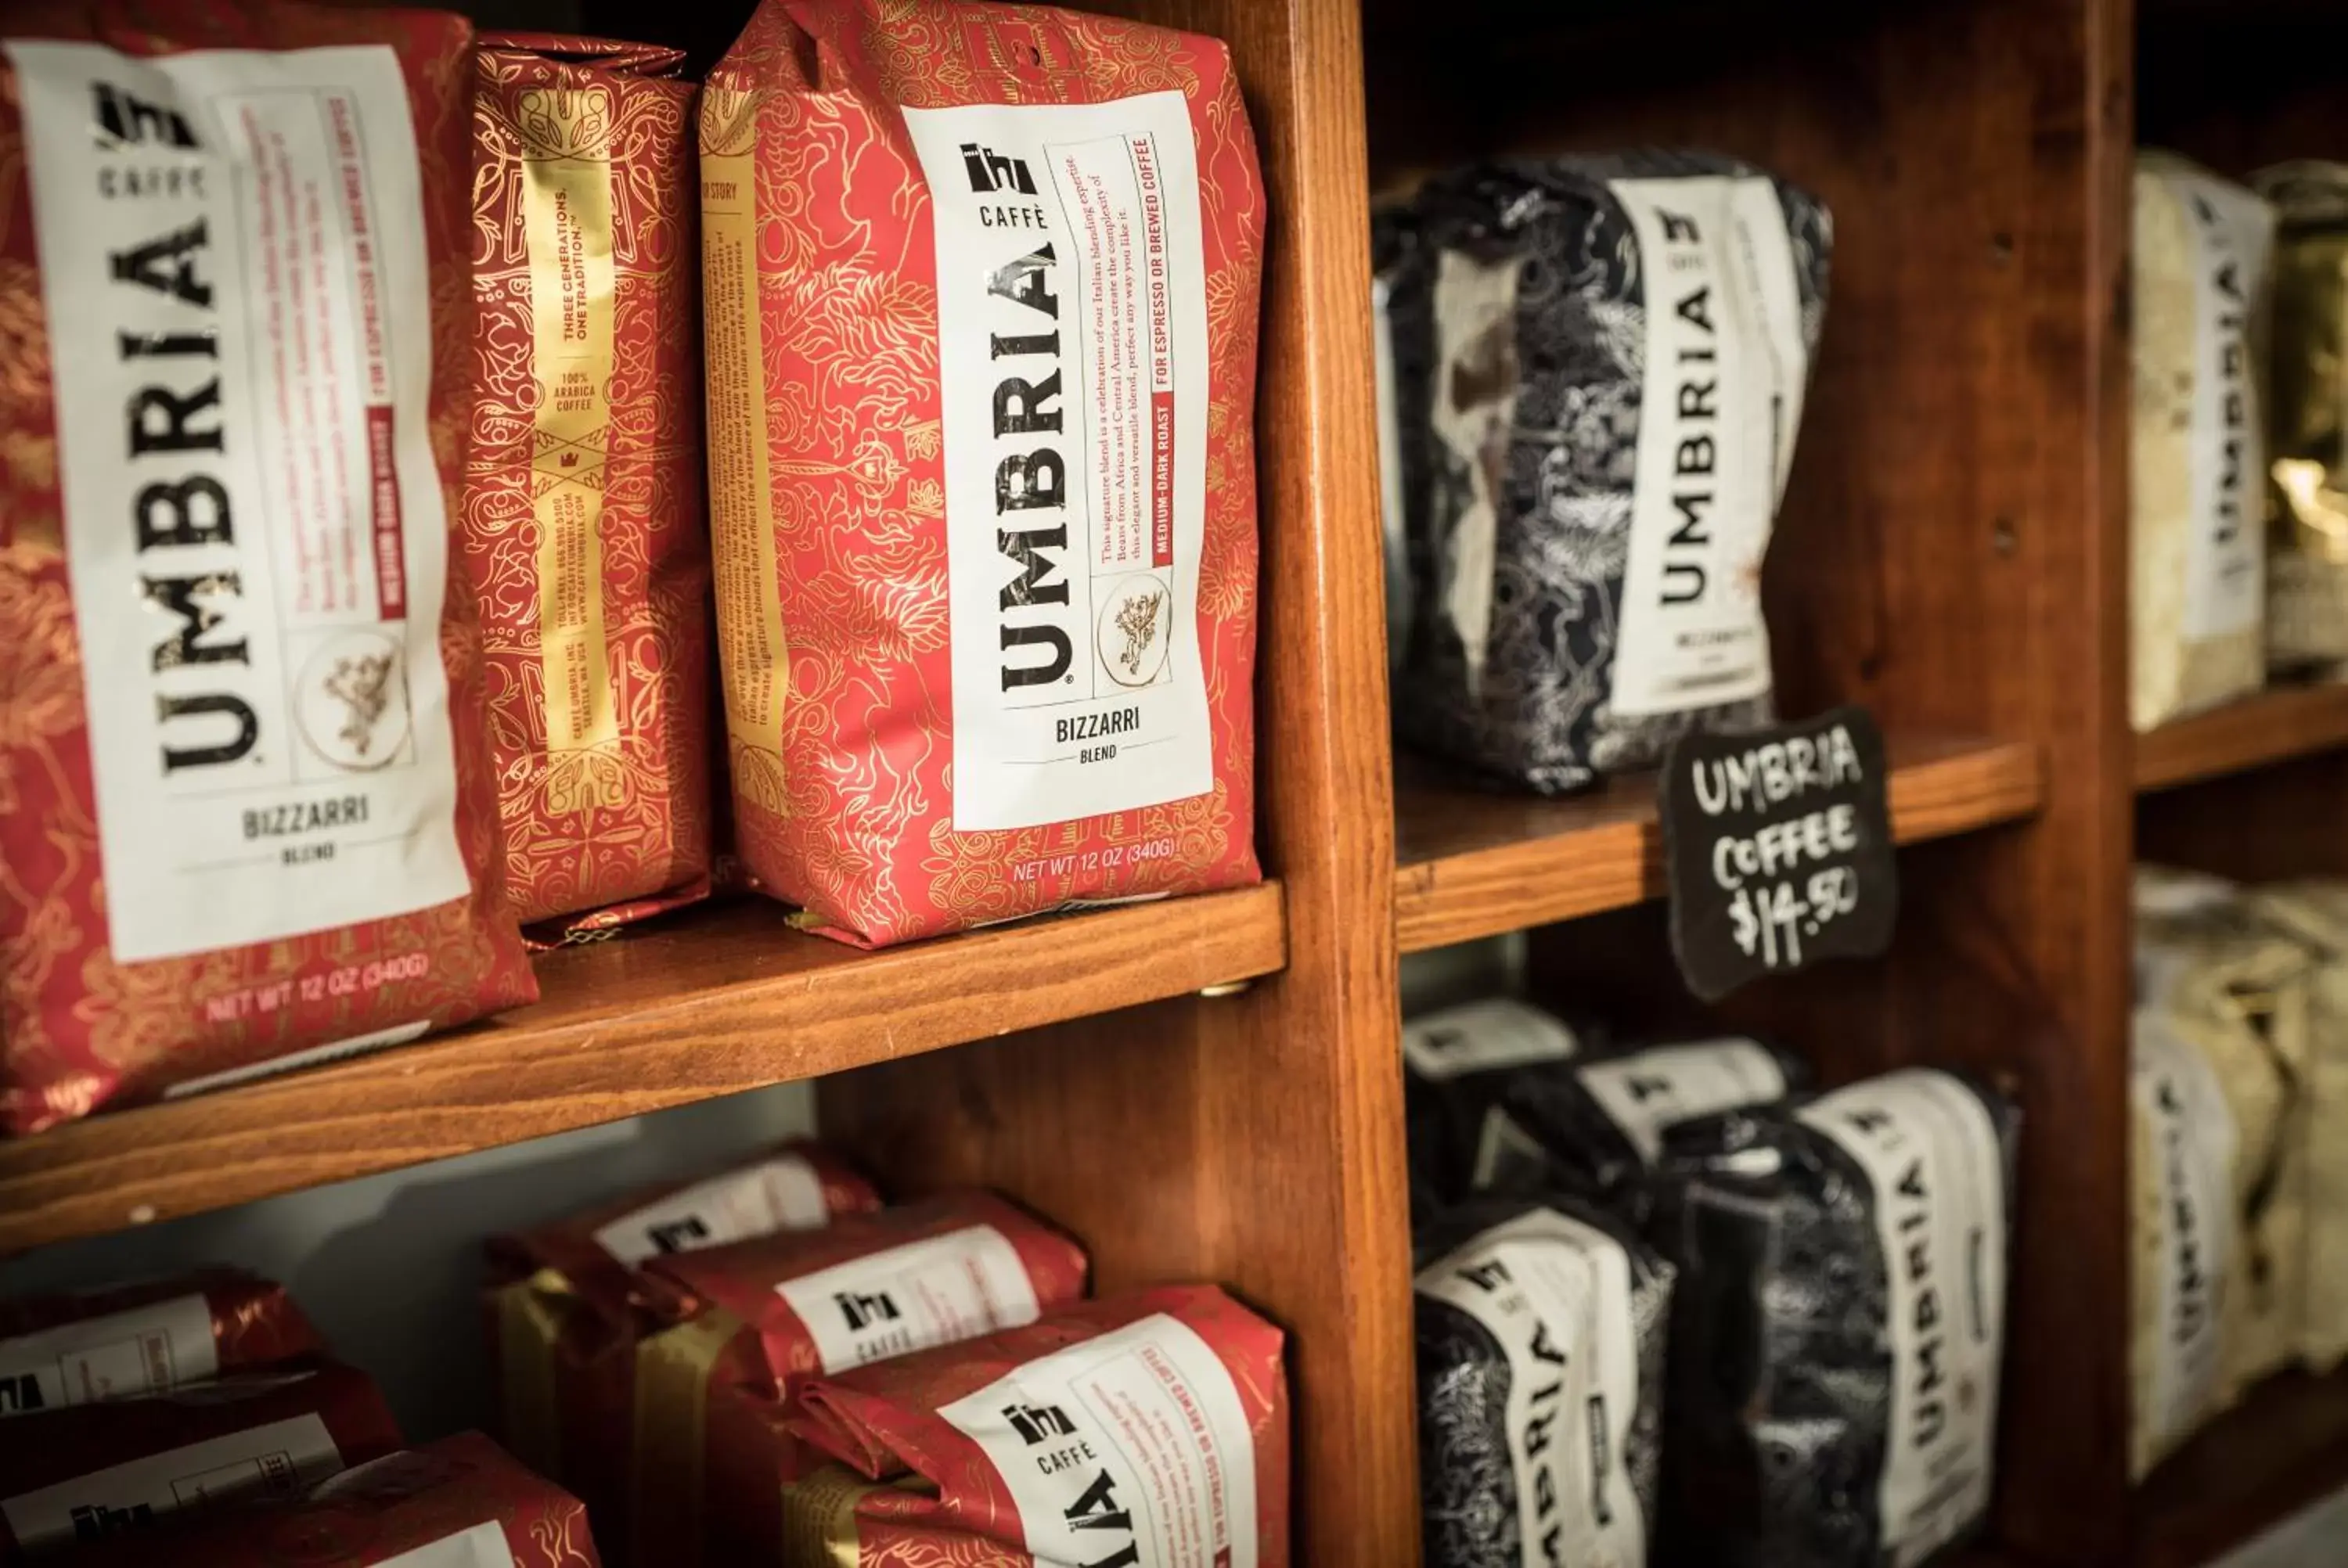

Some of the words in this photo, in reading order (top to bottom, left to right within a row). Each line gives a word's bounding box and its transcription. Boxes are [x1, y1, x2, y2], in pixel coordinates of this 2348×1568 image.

[1064, 155, 1089, 205] expertise.
[1088, 174, 1101, 187] of
[1133, 138, 1155, 189] COFFEE
[711, 182, 737, 201] STORY
[980, 203, 1048, 229] CAFFÈ
[1097, 189, 1115, 254] complexity
[1117, 207, 1127, 220] it.
[1145, 195, 1162, 254] BREWED
[1083, 207, 1101, 259] blending
[1119, 224, 1130, 246] like
[1107, 257, 1118, 276] the
[1124, 250, 1134, 272] you
[1151, 258, 1163, 276] OR
[726, 281, 735, 300] the
[1092, 262, 1104, 303] Italian
[1109, 281, 1120, 316] create
[1125, 275, 1135, 297] way
[563, 296, 574, 342] THREE
[577, 311, 588, 340] ONE
[1095, 307, 1104, 322] our
[1125, 303, 1136, 323] any
[1151, 282, 1167, 353] ESPRESSO
[1093, 329, 1104, 343] of
[1110, 320, 1121, 371] America
[1125, 327, 1138, 369] perfect
[562, 372, 589, 384] 100%
[740, 349, 749, 387] Italian
[1096, 347, 1107, 413] celebration
[1154, 358, 1167, 385] FOR
[554, 383, 595, 397] ARABICA
[556, 398, 592, 412] COFFEE
[741, 392, 750, 412] the
[1111, 376, 1123, 422] Central
[1126, 372, 1138, 409] blend,
[733, 421, 743, 455] blend
[743, 414, 751, 426] of
[1100, 427, 1108, 436] is
[1113, 426, 1123, 448] and
[1128, 414, 1139, 462] versatile
[1156, 406, 1169, 449] ROAST
[744, 430, 754, 480] essence
[1098, 440, 1110, 473] blend
[1657, 286, 1718, 609] UMBRIA
[736, 458, 744, 477] the
[987, 241, 1073, 692] UMBRIA
[1115, 452, 1125, 489] Africa
[1129, 466, 1140, 487] and
[109, 216, 259, 777] UMBRIA
[736, 479, 746, 492] of
[747, 483, 755, 502] the
[1100, 476, 1113, 531] signature
[1156, 454, 1169, 553] MEDIUM-DARK
[738, 494, 748, 541] artistry
[748, 505, 759, 545] reflect
[1115, 493, 1125, 522] from
[1129, 491, 1141, 533] elegant
[751, 548, 760, 571] that
[1101, 534, 1112, 563] This
[1116, 525, 1126, 561] Beans
[1130, 536, 1140, 559] this
[752, 575, 763, 613] blends
[755, 616, 772, 670] signature
[760, 673, 772, 711] create
[759, 714, 768, 725] to
[1056, 707, 1140, 743] BIZZARRI
[1080, 744, 1117, 764] BLEND
[1692, 724, 1863, 816] UMBRIA
[242, 794, 369, 840] BIZZARRI
[1014, 861, 1043, 883] NET
[1050, 858, 1075, 876] WT
[1080, 854, 1098, 872] 12
[1102, 850, 1122, 869] OZ
[1127, 838, 1175, 864] (340G)
[1727, 865, 1859, 968] $14.50
[1037, 1439, 1097, 1475] CAFFÈ
